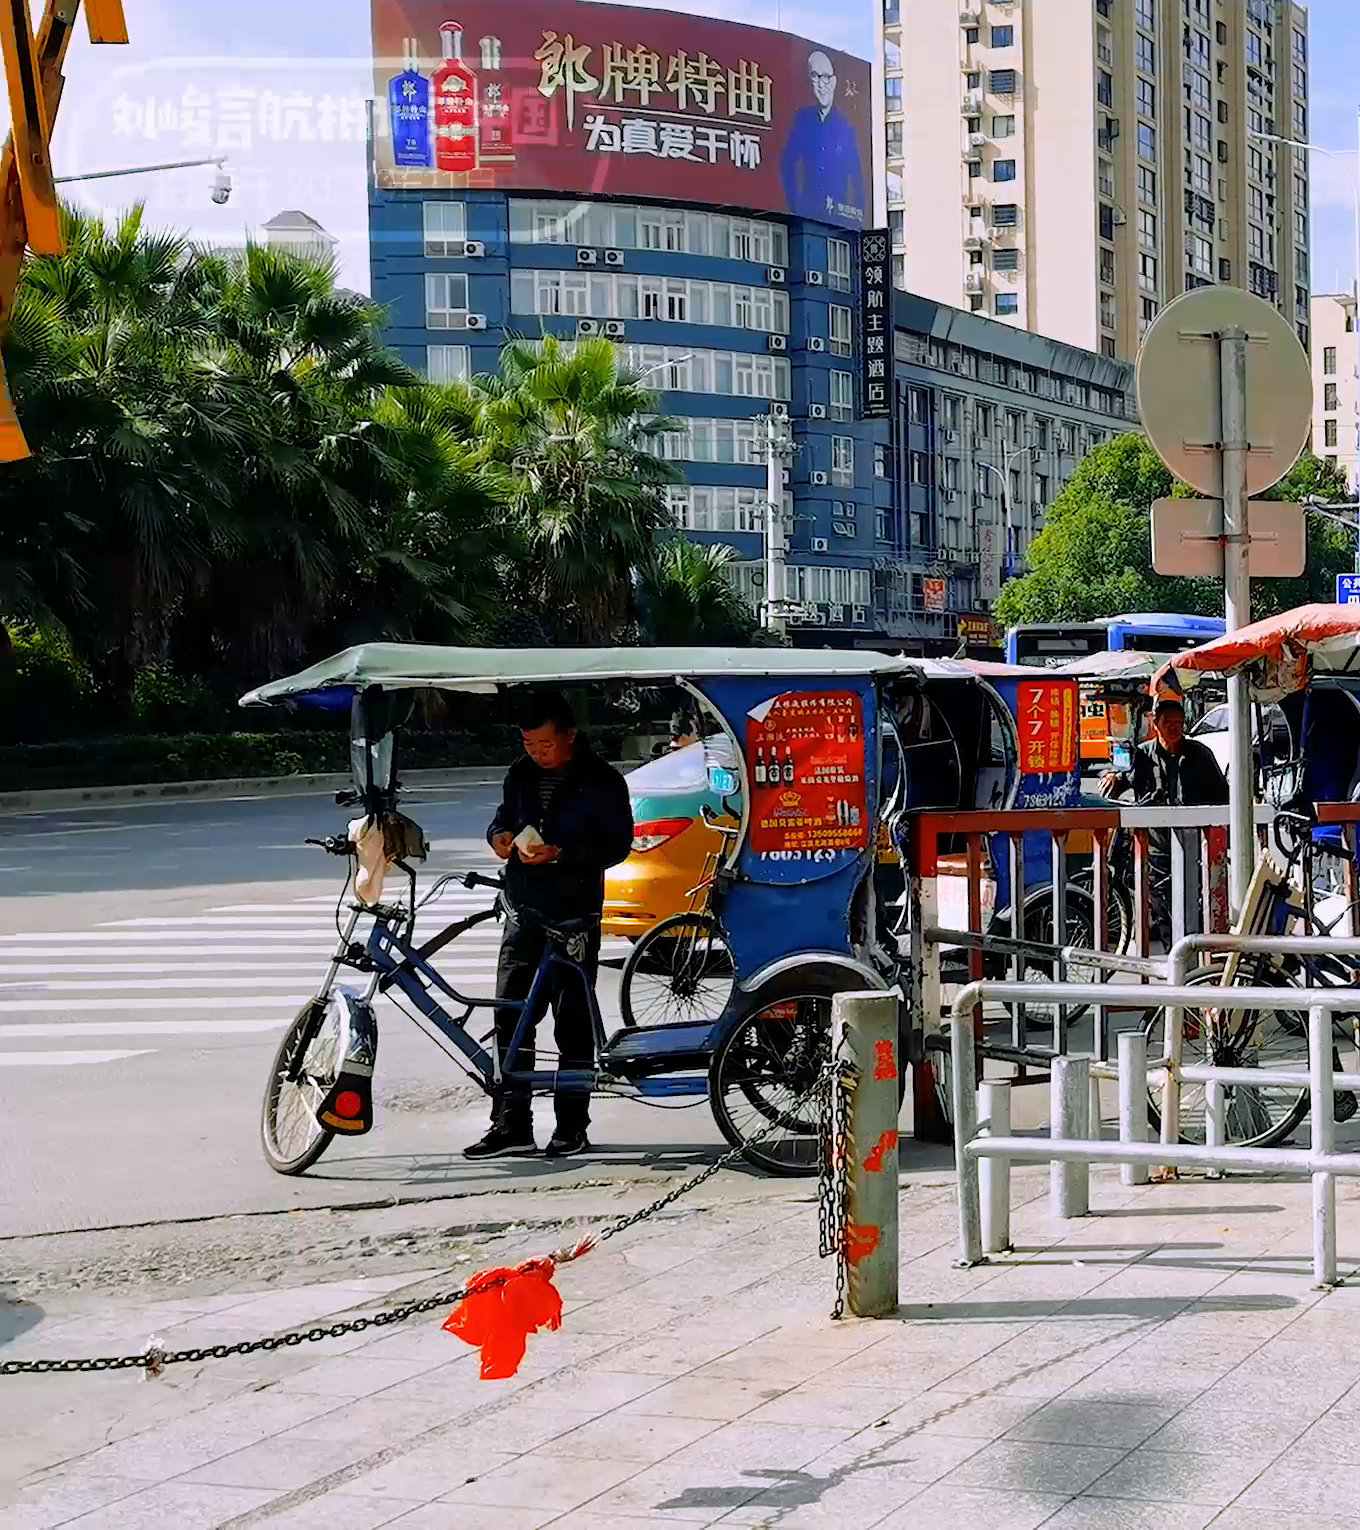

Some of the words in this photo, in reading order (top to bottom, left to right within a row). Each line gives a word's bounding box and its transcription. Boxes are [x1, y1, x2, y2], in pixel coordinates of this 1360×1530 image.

[534, 29, 773, 132] 郎牌特曲
[582, 114, 762, 169] 为真爱干杯
[865, 265, 885, 401] 领航主题酒店
[1026, 688, 1046, 768] 7个7开锁
